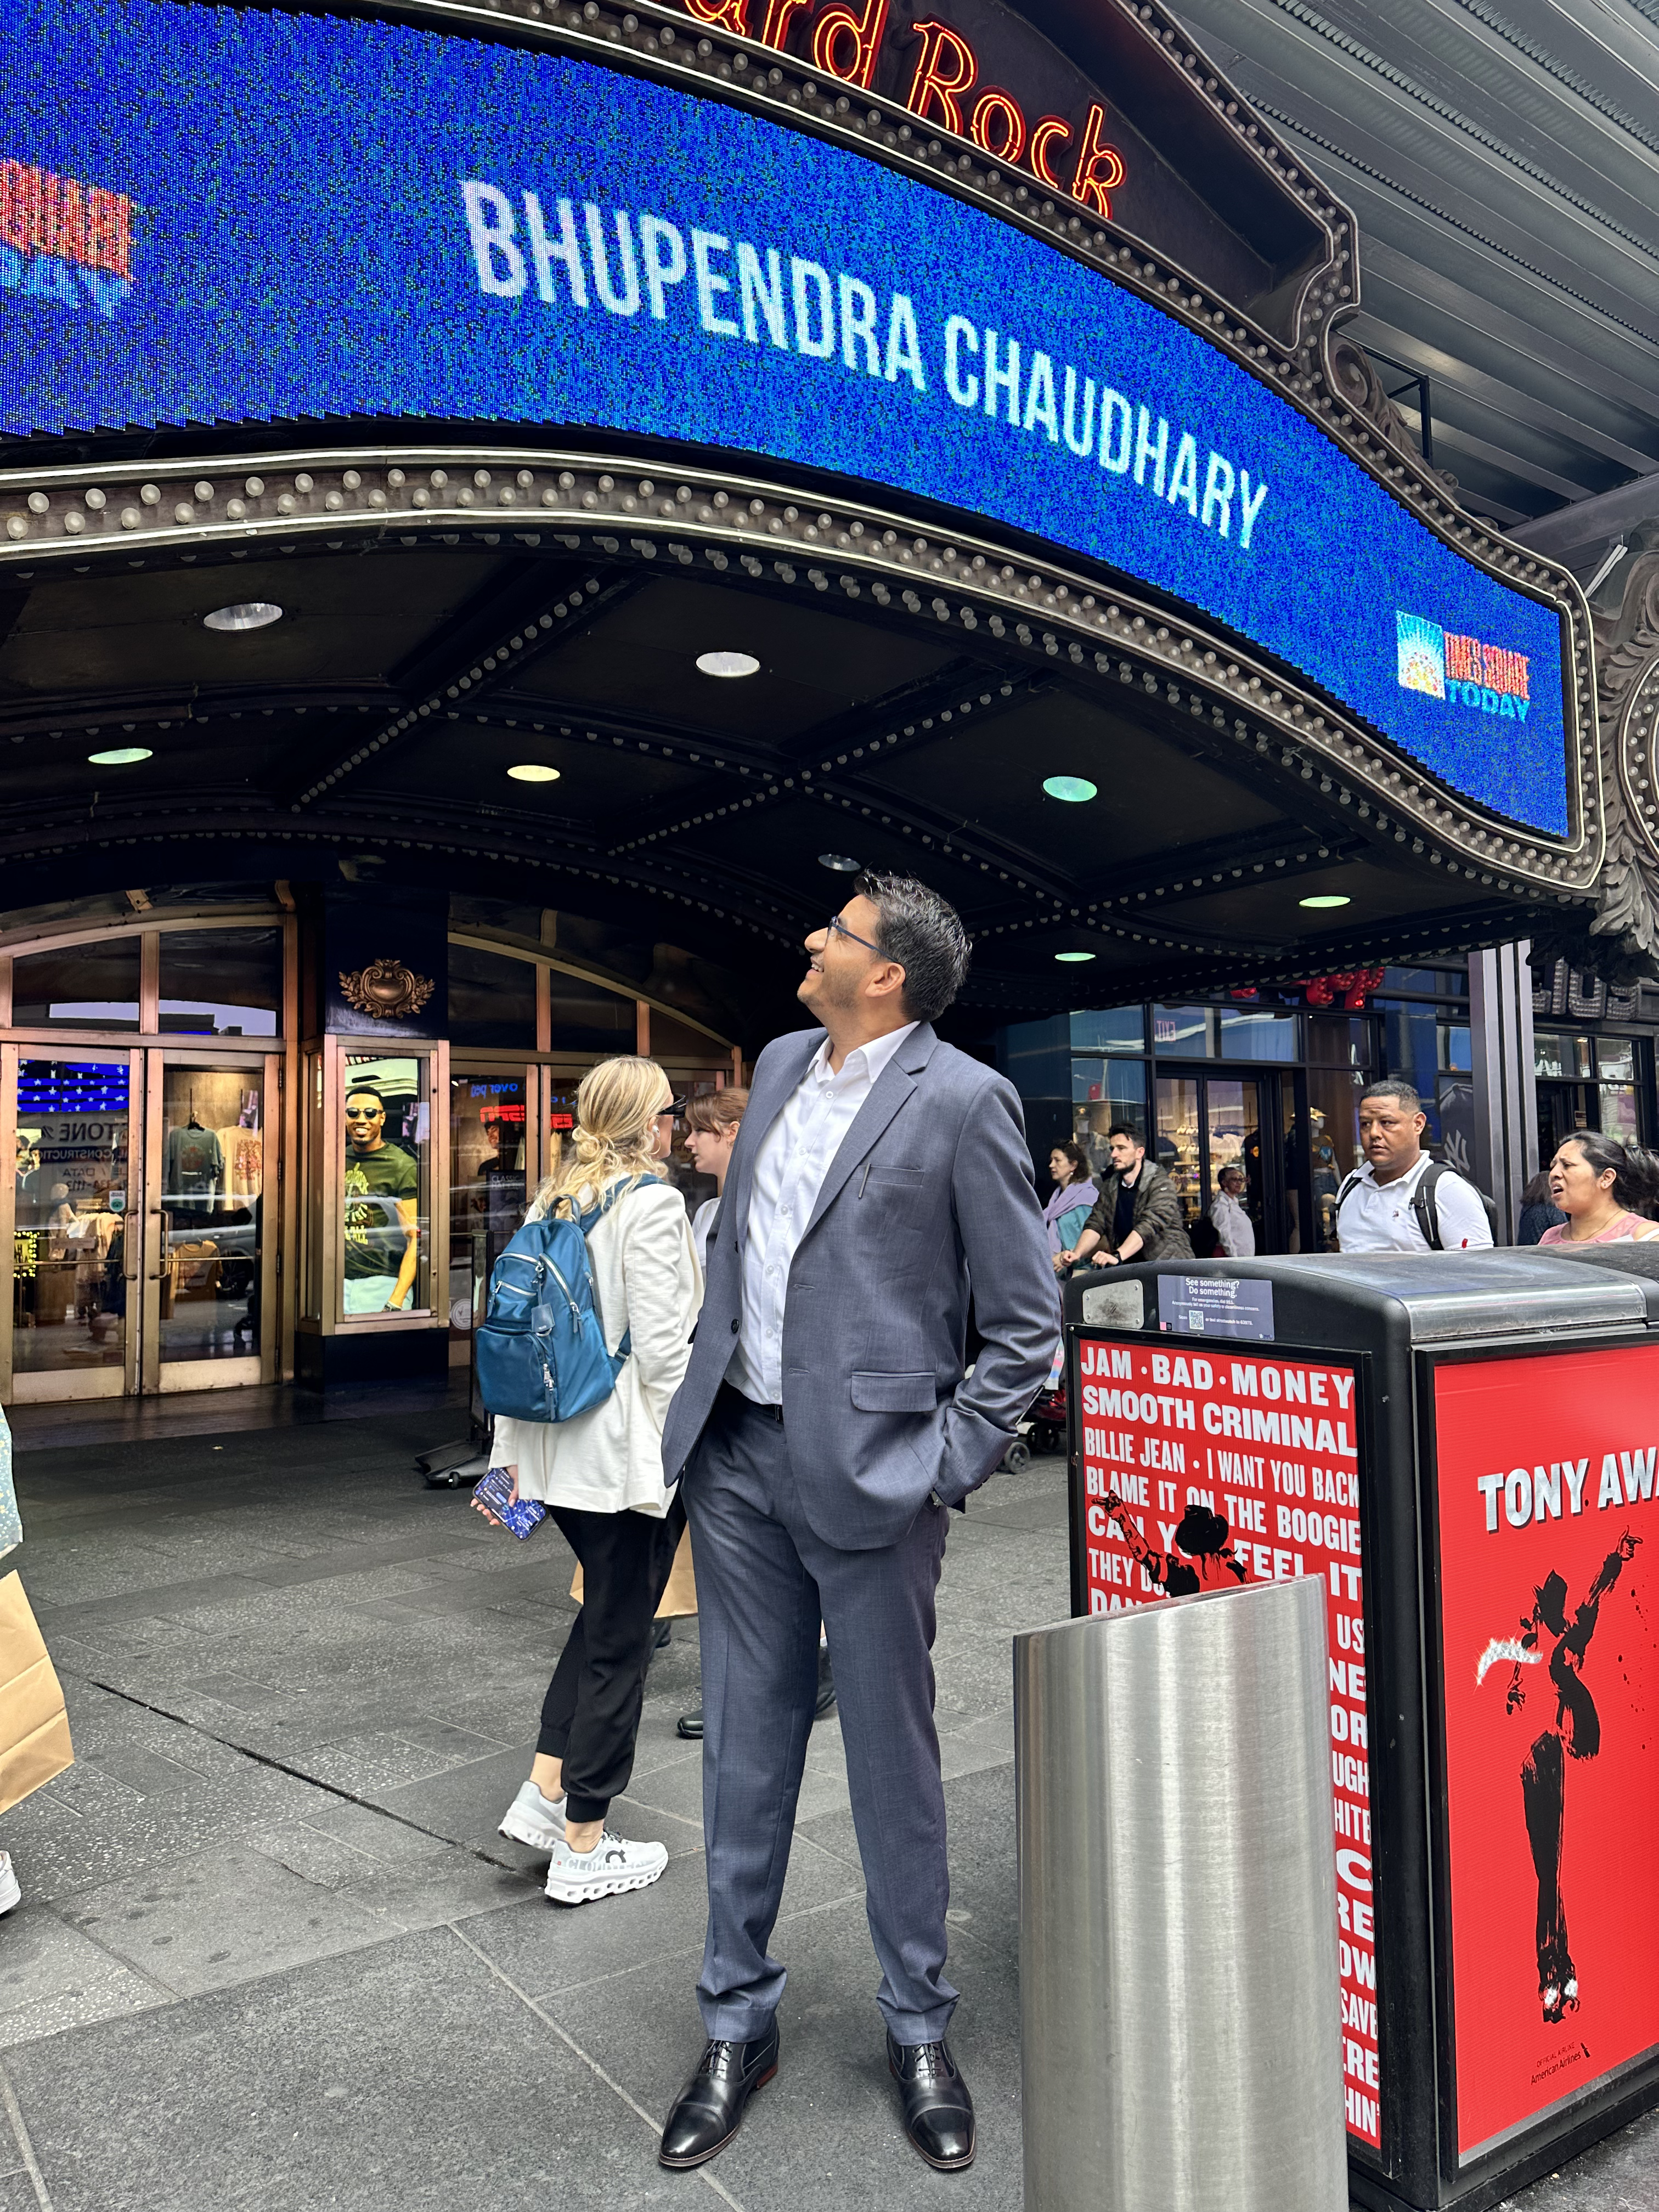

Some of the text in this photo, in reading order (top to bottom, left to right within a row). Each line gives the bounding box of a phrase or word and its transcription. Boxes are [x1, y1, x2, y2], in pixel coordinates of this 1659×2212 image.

[908, 15, 1126, 218] Rock
[460, 180, 1268, 549] BHUPENDRA CHAUDHARY
[1444, 678, 1530, 723] TODAY
[1186, 1278, 1240, 1289] See something?
[1189, 1286, 1238, 1299] Do something.
[1081, 1347, 1354, 1409] JAM BAD MONEY
[1083, 1385, 1358, 1457] SMOOTH CRIMINAL
[1085, 1427, 1359, 1509] BILLIE JEAN I WANT YOU BACK
[1477, 1446, 1659, 1534] TONY AW
[1086, 1466, 1361, 1555] BLAME IT ON THE BOOGIE
[1088, 1547, 1134, 1587] THEY
[1329, 1561, 1363, 1601] IT
[1091, 1587, 1142, 1615] DA
[1336, 1613, 1364, 1655] US
[1330, 1704, 1368, 1750] OR
[1332, 1750, 1369, 1797] UGH
[1342, 2035, 1379, 2090] RE
[1531, 2051, 1581, 2086] American Airlines
